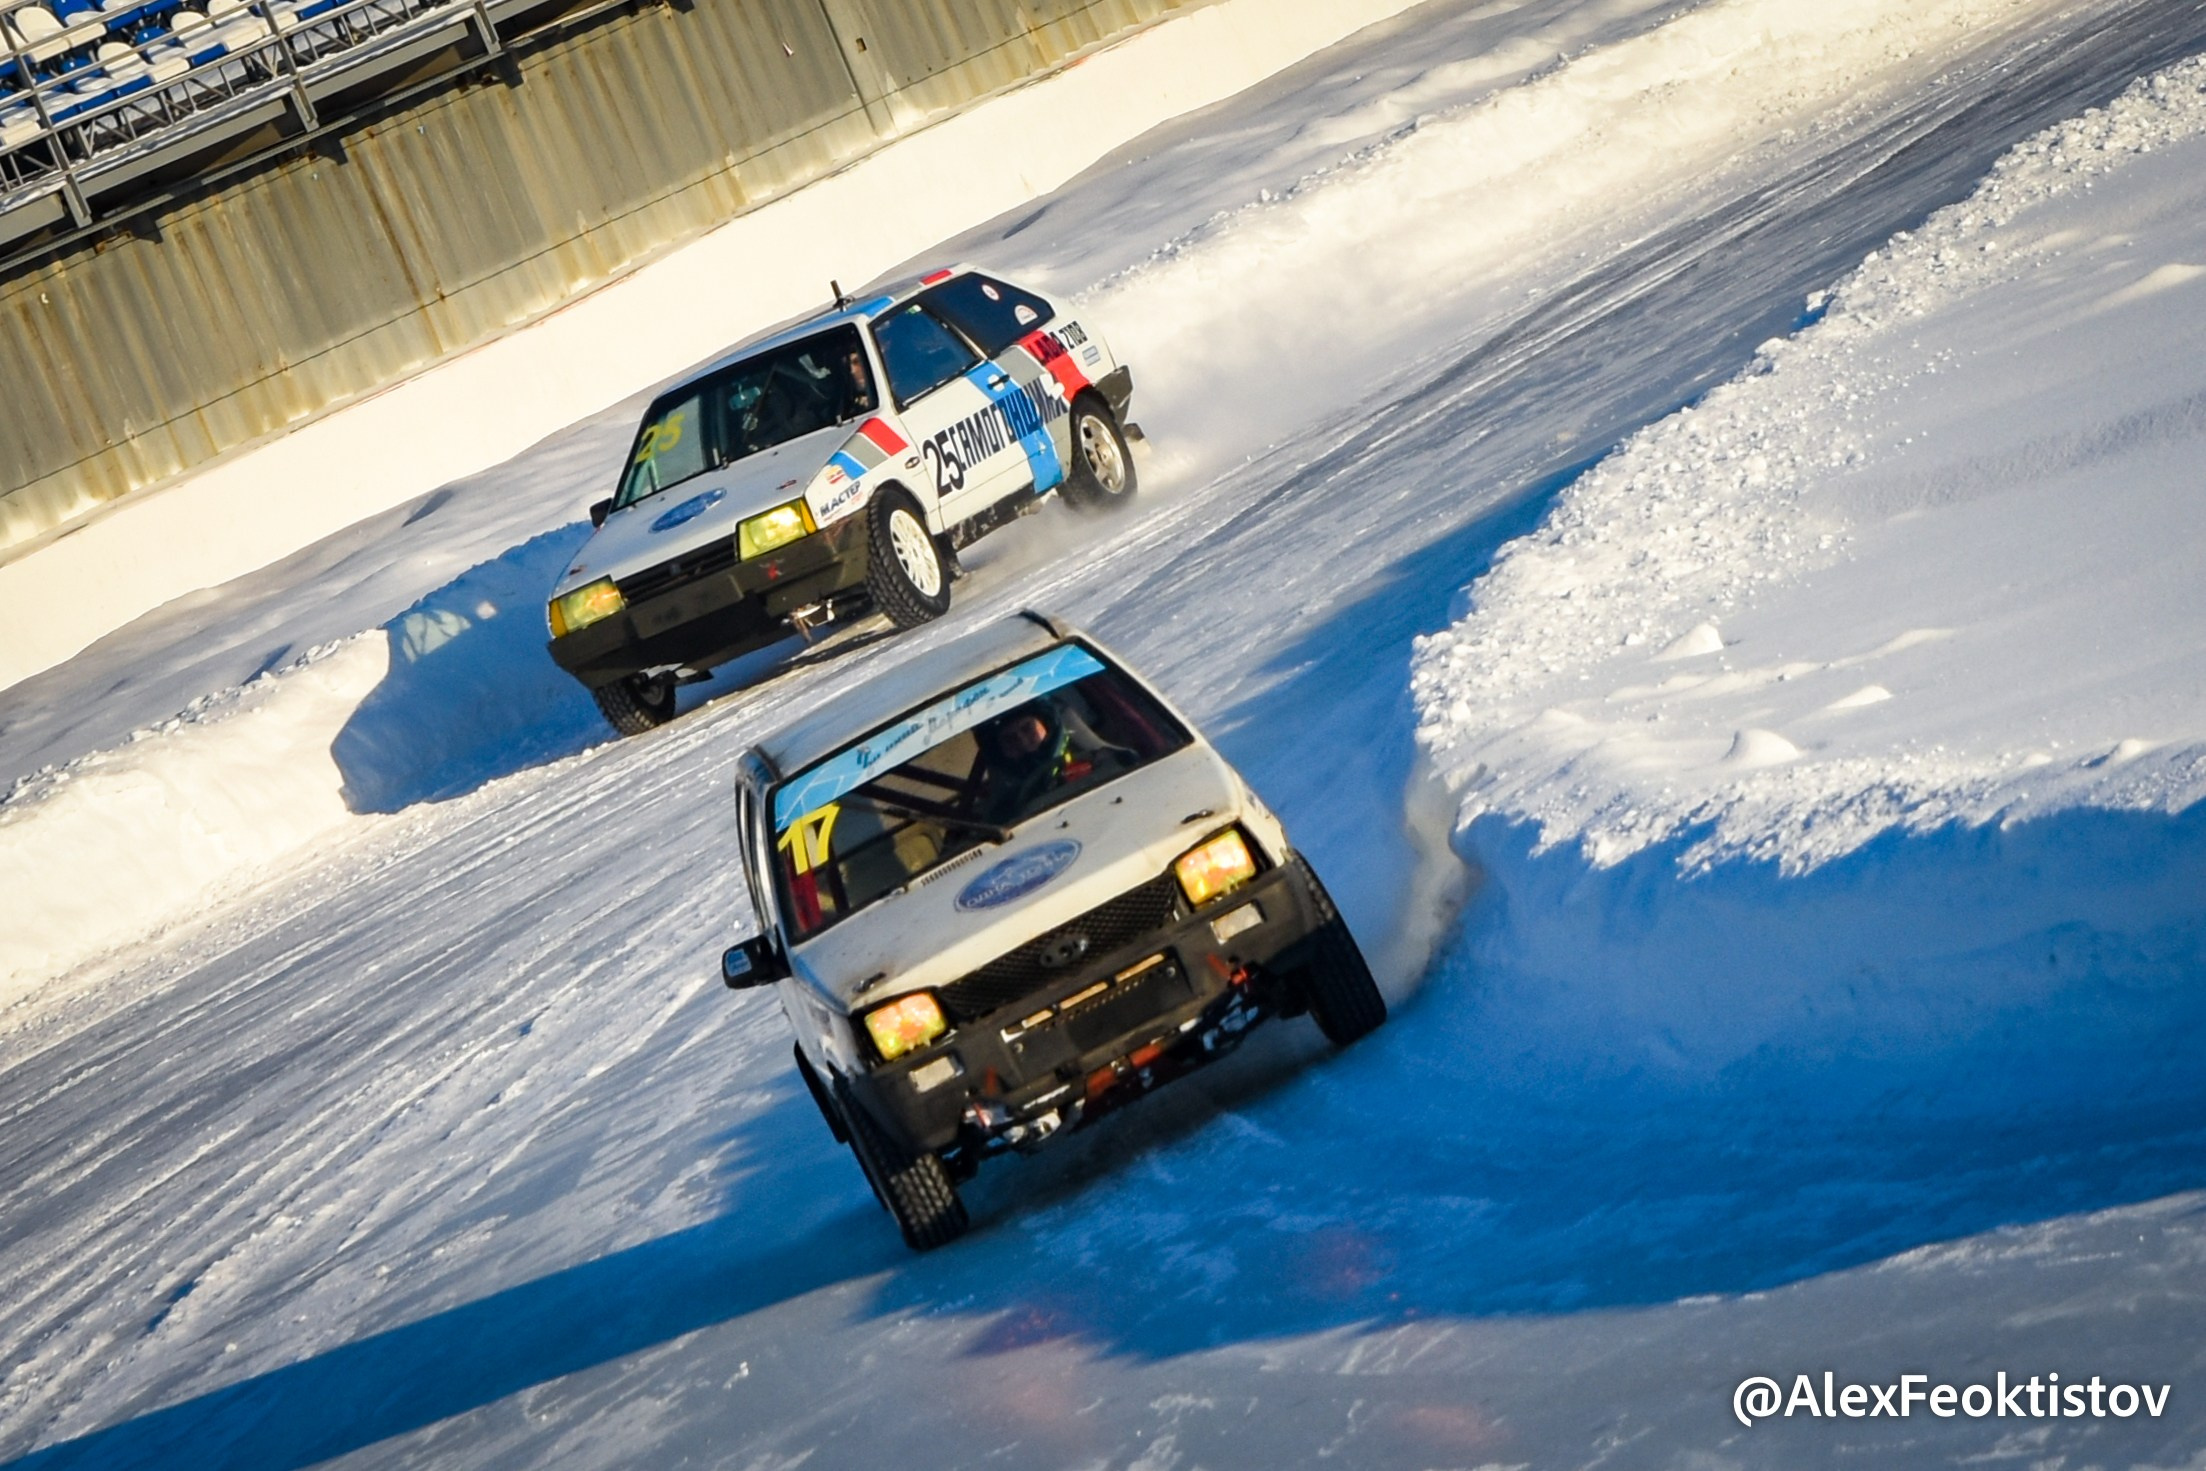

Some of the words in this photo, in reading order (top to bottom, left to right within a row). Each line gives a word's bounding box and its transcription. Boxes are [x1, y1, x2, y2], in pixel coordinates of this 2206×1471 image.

[633, 412, 686, 464] 25
[923, 429, 966, 498] 25
[819, 480, 862, 518] МАСТЕР
[777, 801, 841, 875] 17
